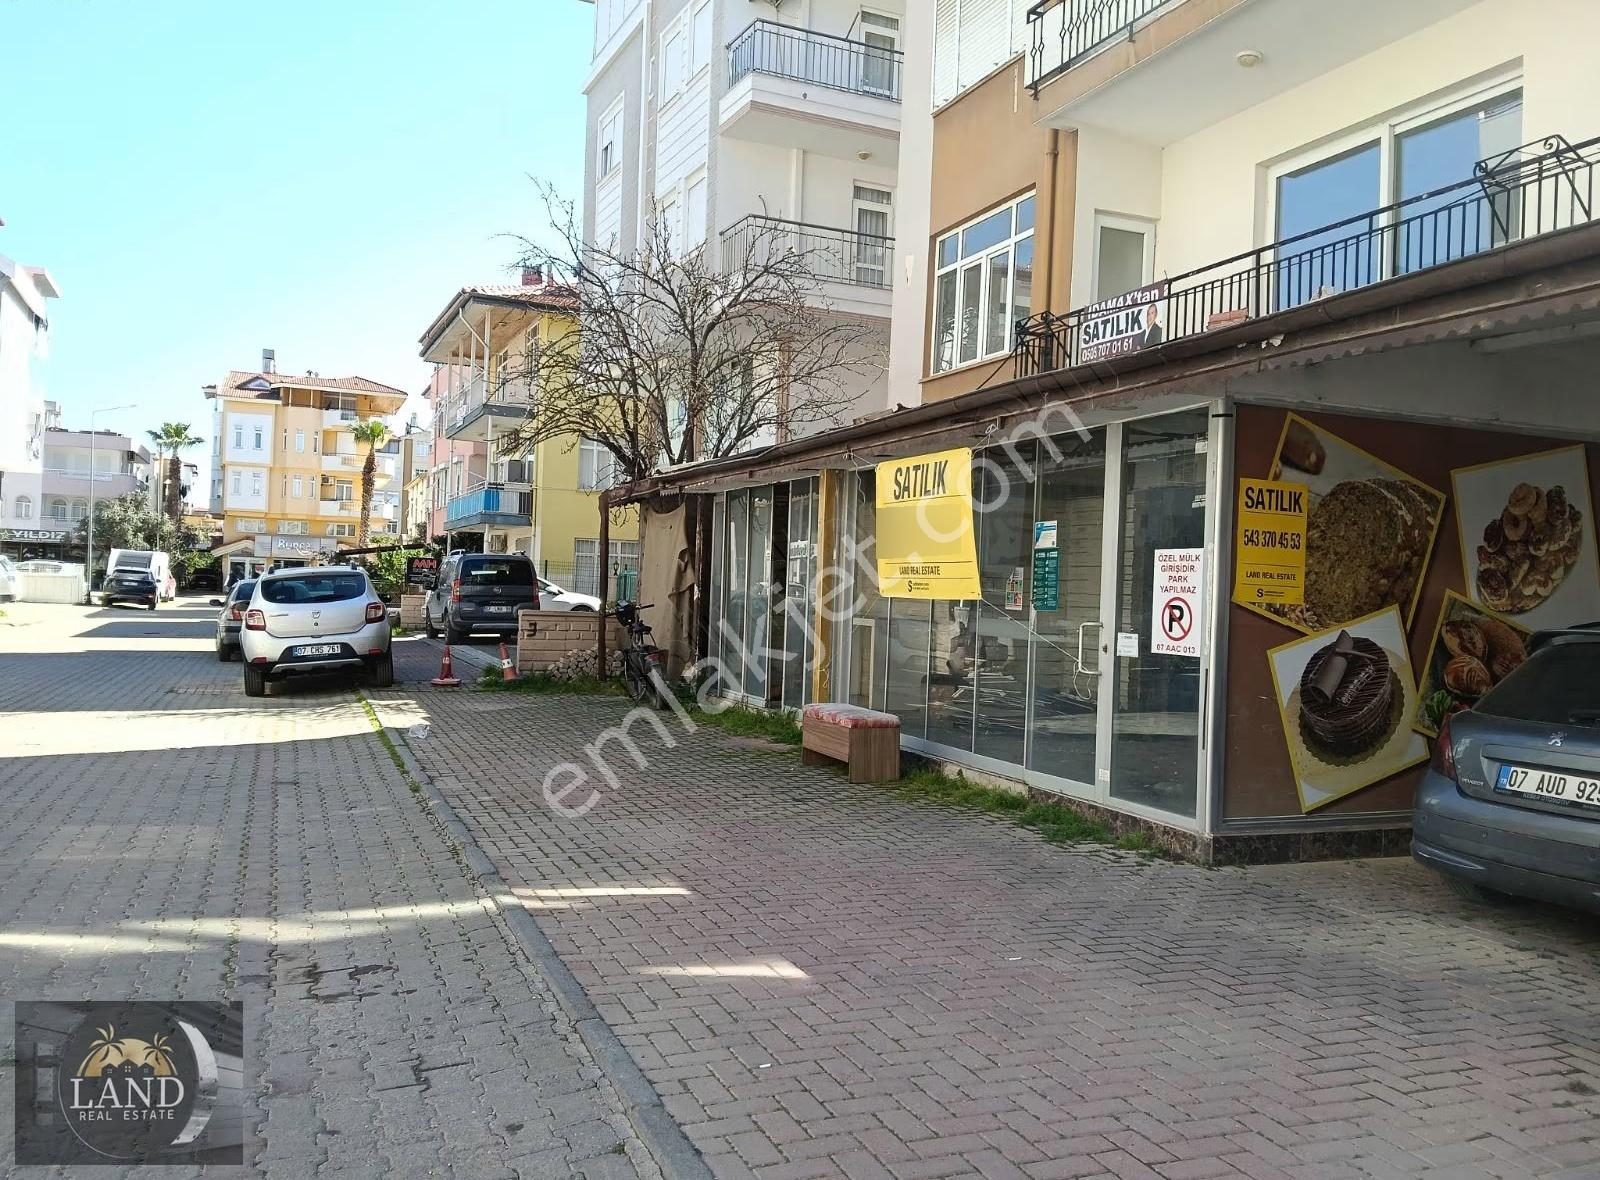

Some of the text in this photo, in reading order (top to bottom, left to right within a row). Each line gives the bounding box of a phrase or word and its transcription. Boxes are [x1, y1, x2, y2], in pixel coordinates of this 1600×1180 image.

[1082, 309, 1142, 345] SATILIK
[1099, 342, 1111, 357] 707
[1112, 340, 1121, 353] 01
[1123, 337, 1133, 351] 61
[894, 459, 948, 500] SATILIK
[1245, 487, 1303, 513] SATILIK
[12, 530, 66, 539] YILDIZ
[1244, 529, 1300, 550] 543 370 45 53
[1158, 552, 1200, 563] ÖZEL MÜLK
[899, 565, 940, 575] LAND REAL ESTATE
[1168, 575, 1188, 583] PARK
[1262, 572, 1276, 580] REAL
[1277, 573, 1296, 581] ESTATE
[1160, 585, 1197, 594] YAPILMAZ
[311, 646, 324, 654] CHS
[1183, 646, 1196, 654] 013
[1508, 769, 1529, 788] 07
[1536, 774, 1567, 796] AUD
